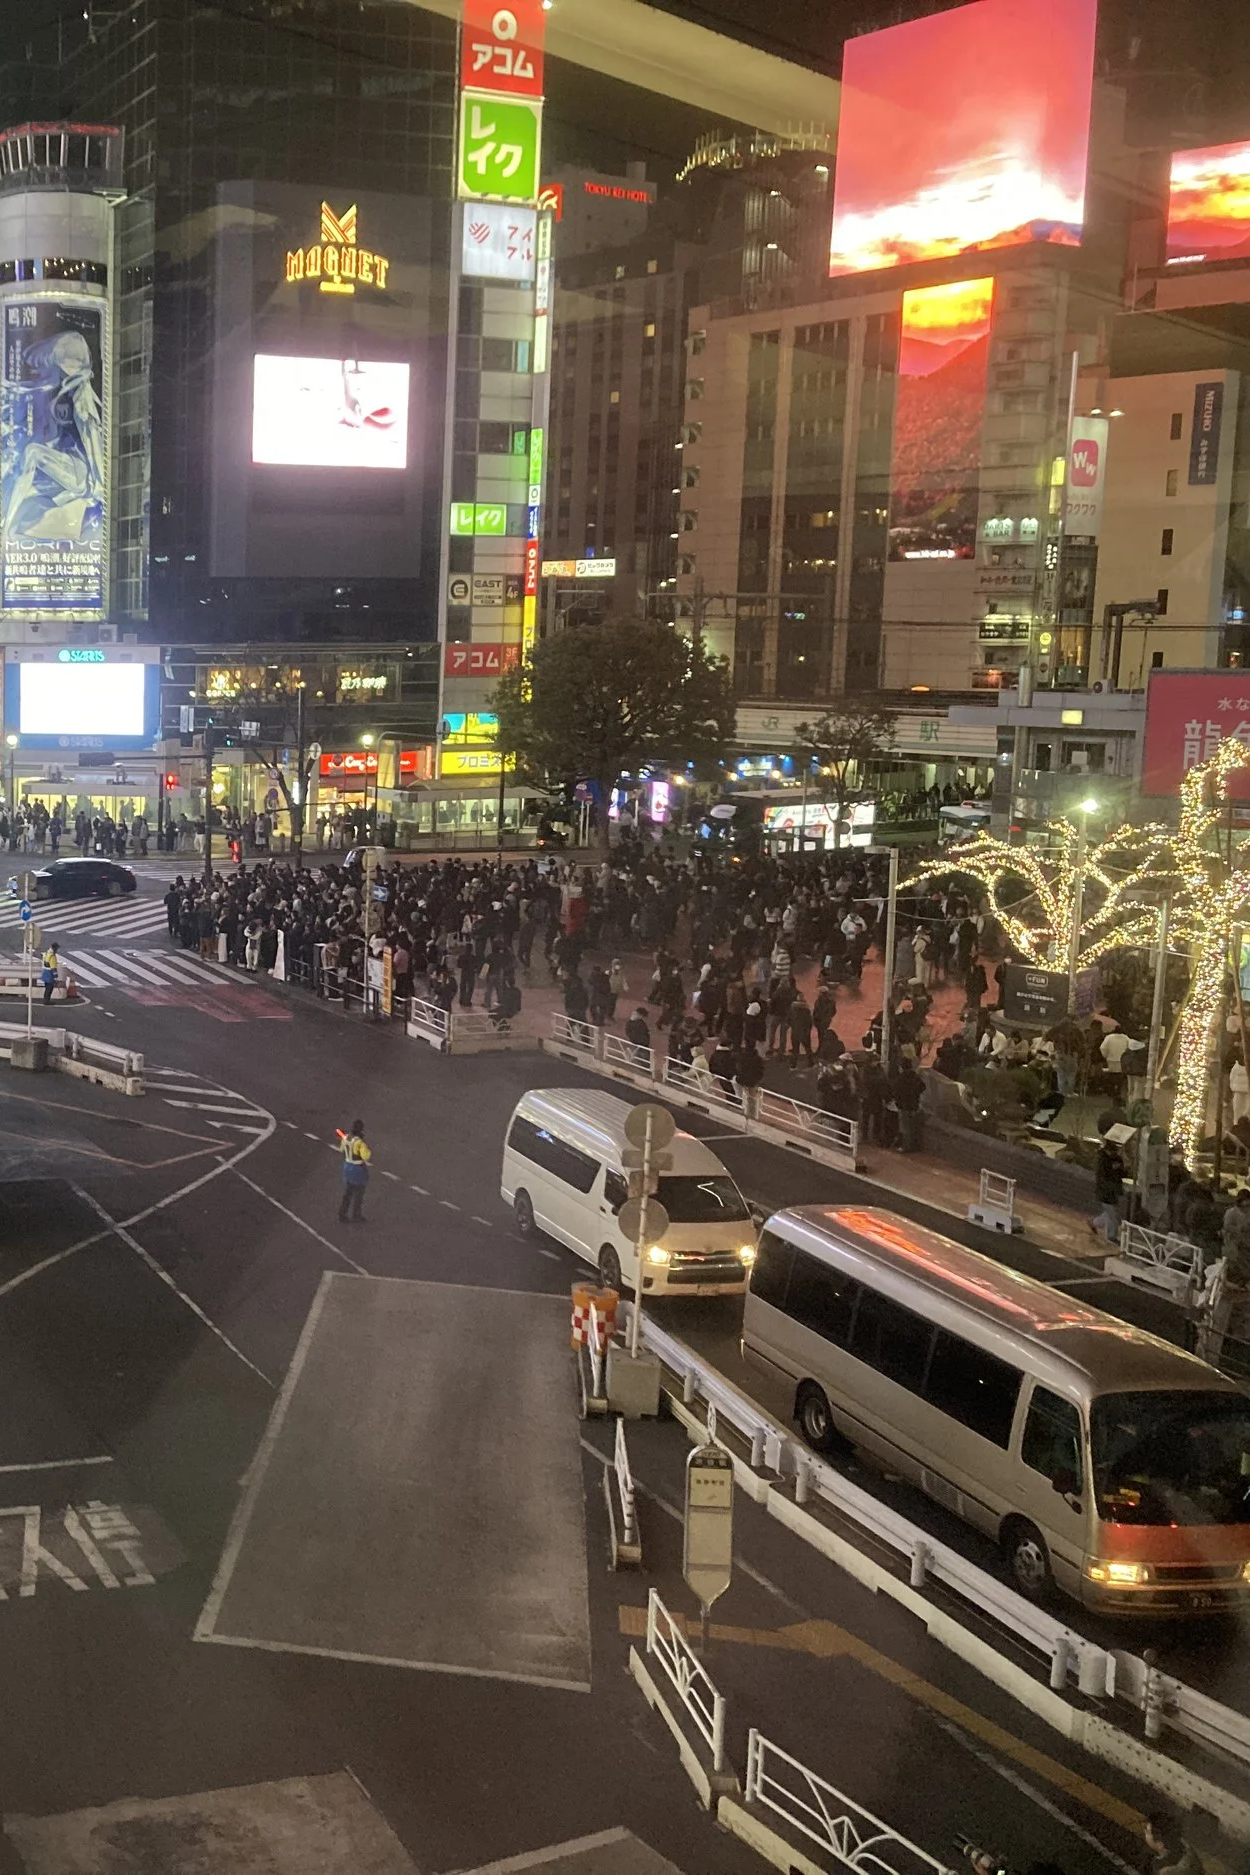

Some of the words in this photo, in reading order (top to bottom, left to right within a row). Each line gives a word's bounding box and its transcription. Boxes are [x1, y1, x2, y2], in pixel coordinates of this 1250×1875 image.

[471, 43, 534, 79] アコム
[584, 182, 611, 196] TOKYU
[286, 246, 389, 289] MAGNET
[460, 509, 502, 527] レイク
[453, 651, 499, 667] アコム
[762, 716, 779, 729] JR
[920, 720, 940, 742] 駅
